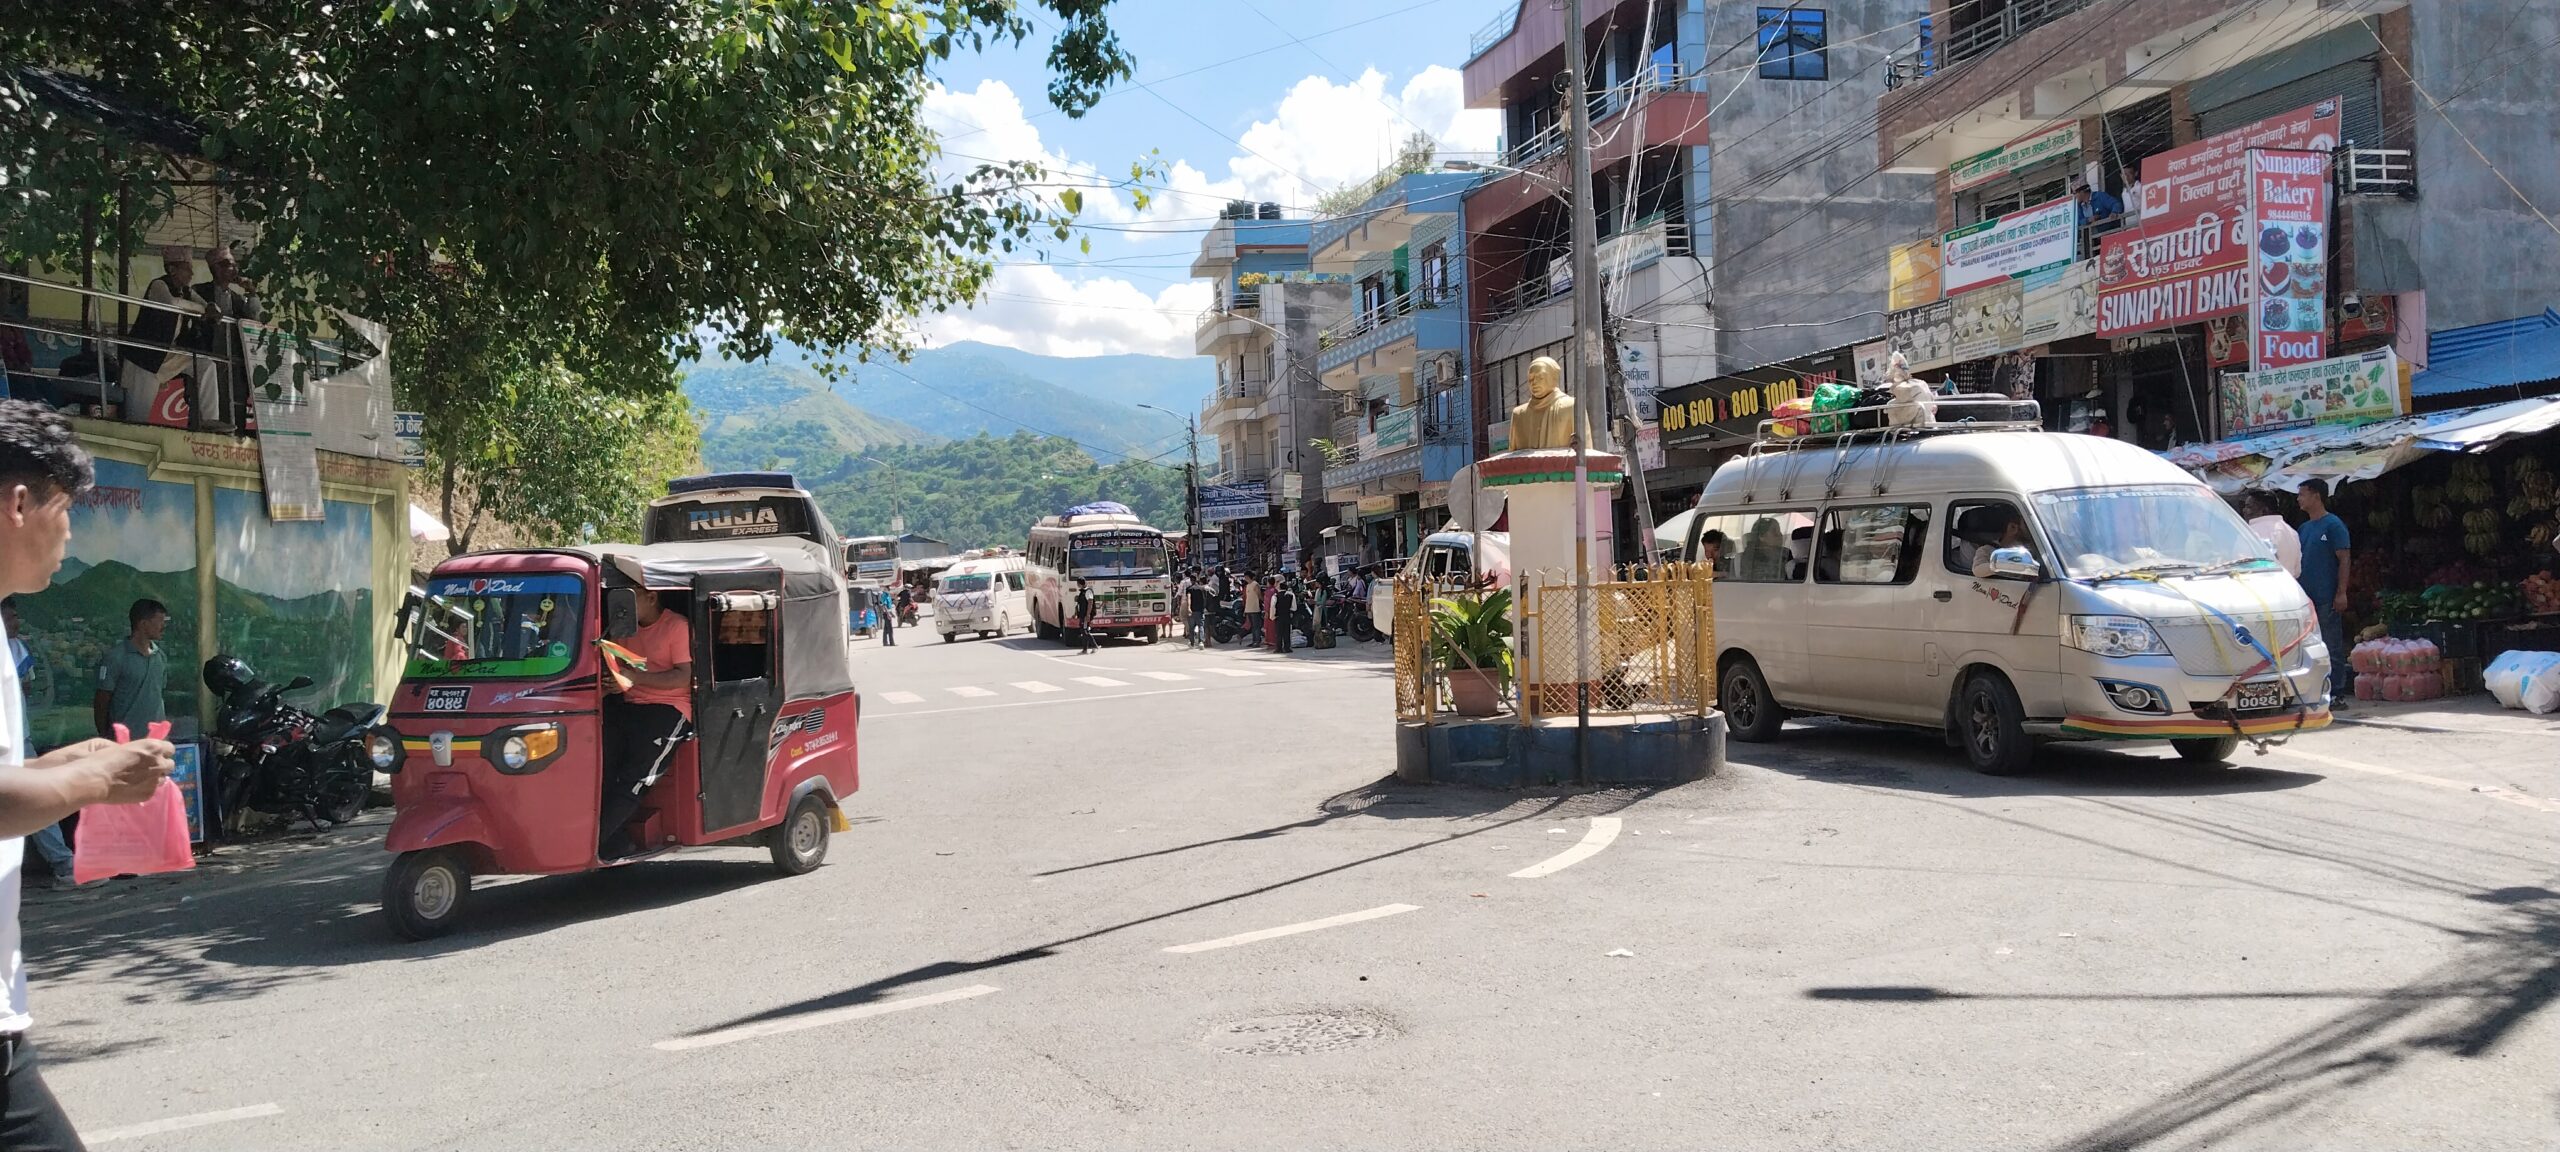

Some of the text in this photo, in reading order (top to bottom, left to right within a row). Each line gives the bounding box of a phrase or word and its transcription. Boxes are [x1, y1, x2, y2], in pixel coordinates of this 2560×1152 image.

[2168, 158, 2188, 173] नेपाल
[2226, 138, 2244, 154] पार्टी
[2256, 150, 2322, 181] Sunapati
[2206, 163, 2223, 176] Party
[2180, 183, 2215, 203] जिल्ला
[2217, 169, 2241, 190] पार्टी
[2262, 178, 2316, 211] Bakery
[1644, 246, 1662, 257] Daily
[2127, 211, 2225, 279] सुनापति
[2100, 266, 2249, 332] SUNAPATI BAKE
[2264, 335, 2320, 359] Food
[2323, 359, 2345, 377] तरकारी
[1662, 403, 1686, 432] 400
[1689, 397, 1714, 428] 600
[1731, 387, 1759, 419] 800
[1763, 378, 1798, 412] 1000
[690, 507, 778, 530] RUJA
[732, 525, 778, 536] EXPRESS
[491, 580, 524, 593] Dad
[2000, 594, 2020, 609] Dad
[463, 664, 499, 675] Dad
